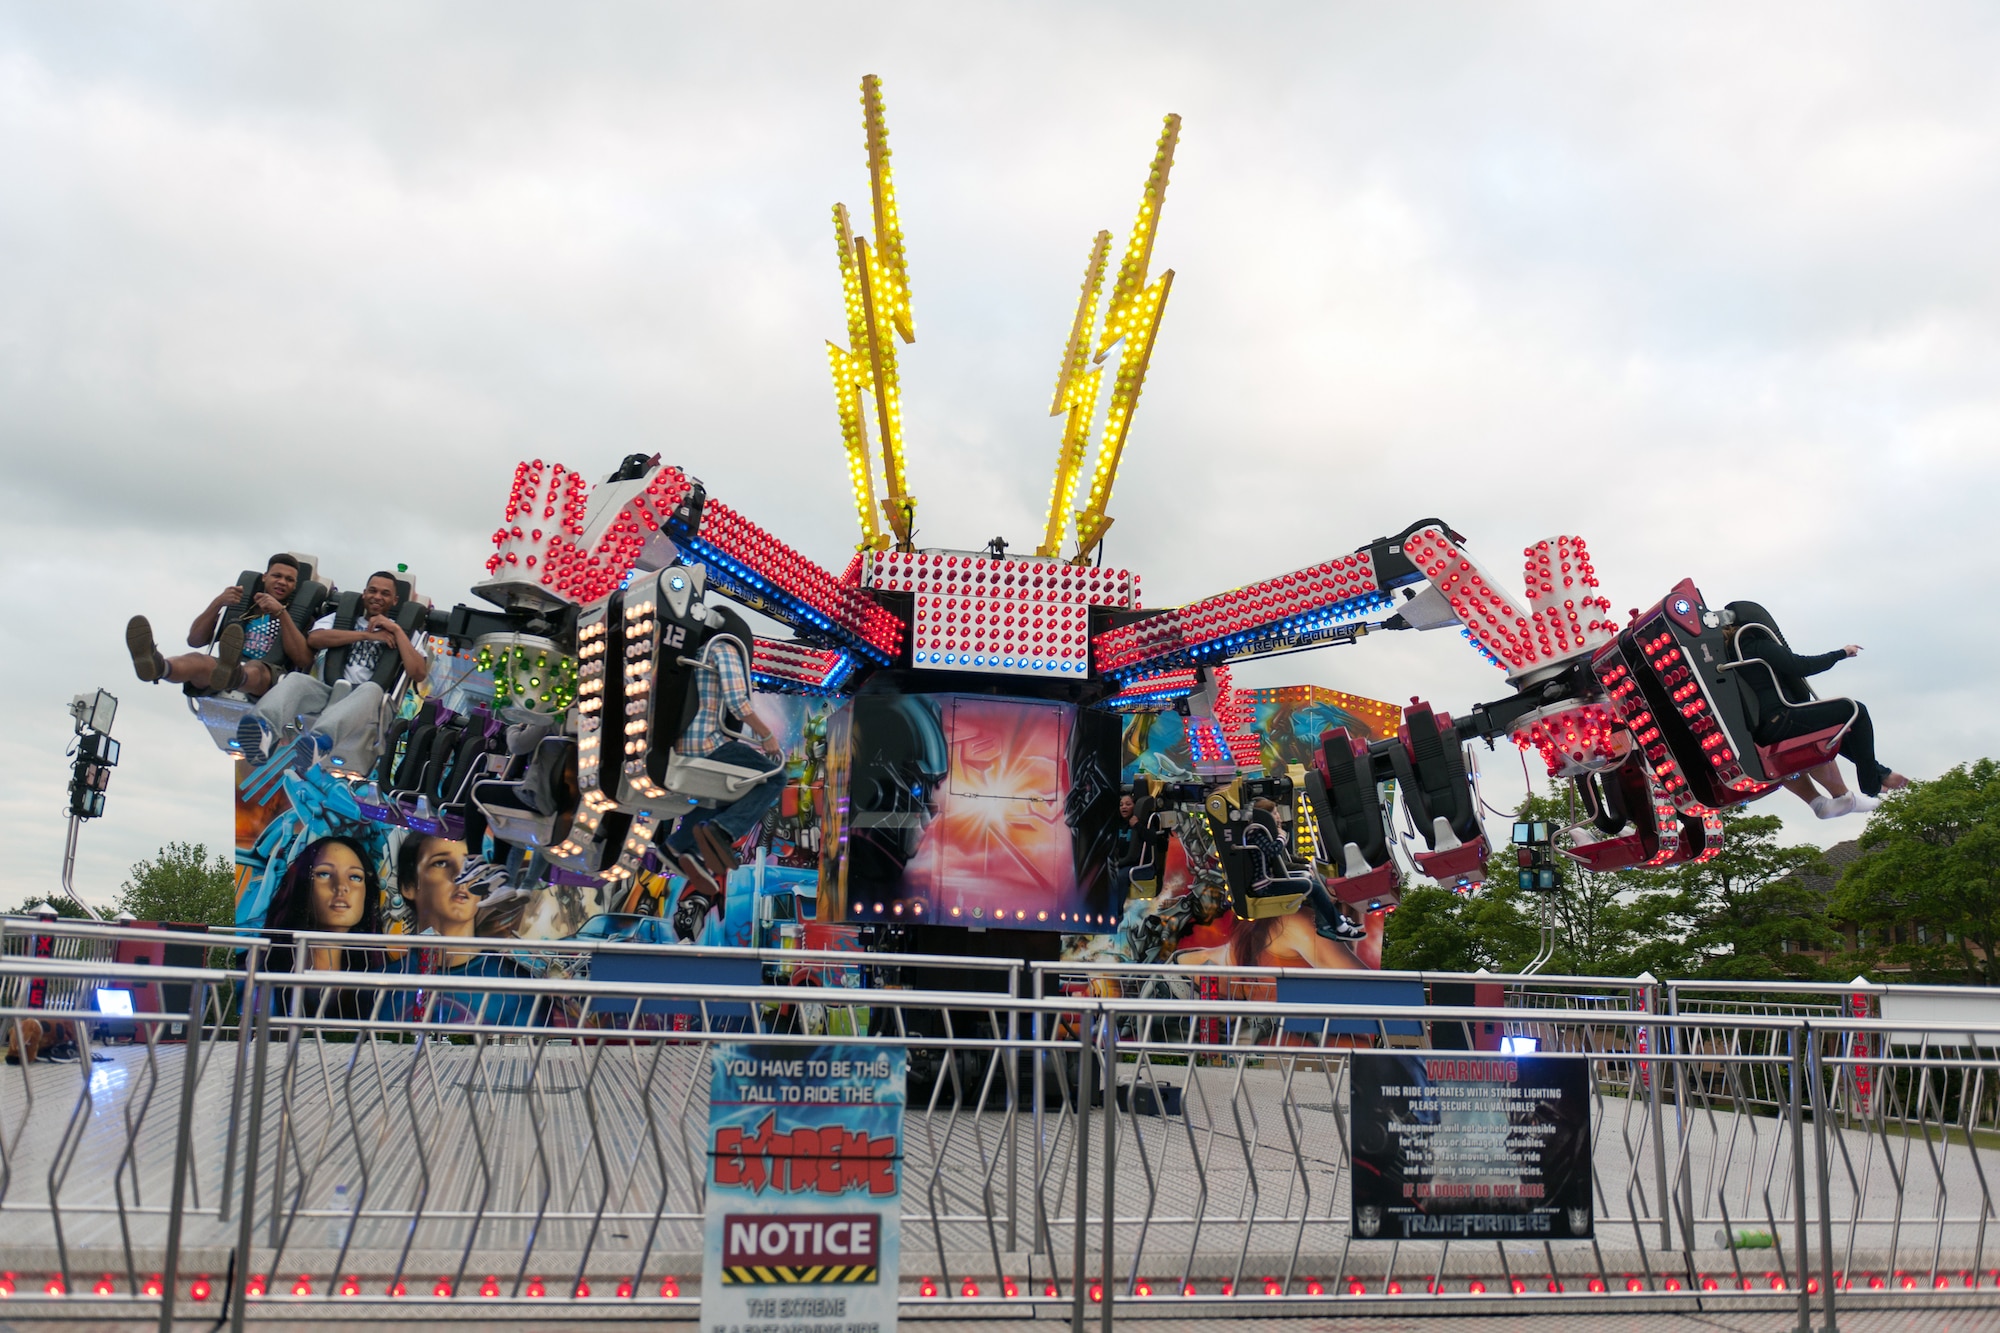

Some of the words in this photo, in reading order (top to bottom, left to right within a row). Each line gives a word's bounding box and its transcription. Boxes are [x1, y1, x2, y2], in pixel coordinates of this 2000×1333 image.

[663, 623, 687, 649] 12
[1226, 636, 1296, 657] EXTREME
[1301, 625, 1357, 644] POWER
[1701, 643, 1713, 663] 1
[1224, 829, 1232, 842] 5
[725, 1060, 757, 1077] YOU
[761, 1060, 804, 1077] HAVE
[807, 1060, 827, 1077] TO
[831, 1061, 850, 1078] BE
[855, 1061, 890, 1078] THIS
[1426, 1060, 1519, 1083] WARNING
[739, 1085, 776, 1102] TALL
[780, 1086, 800, 1102] TO
[804, 1086, 840, 1102] RIDE
[844, 1086, 874, 1103] THE
[1381, 1085, 1401, 1097] THIS
[1402, 1086, 1422, 1097] RIDE
[1424, 1086, 1465, 1098] OPERATES
[1467, 1087, 1489, 1098] WITH
[1491, 1087, 1522, 1098] STROBE
[1524, 1088, 1562, 1099] LIGHTING
[1408, 1100, 1439, 1111] PLEASE
[1441, 1101, 1472, 1112] SECURE
[1474, 1101, 1489, 1112] ALL
[1491, 1101, 1536, 1112] VALUABLES
[1388, 1121, 1442, 1134] Management
[1444, 1123, 1460, 1133] will
[1461, 1124, 1475, 1133] not
[1477, 1124, 1487, 1133] be
[1489, 1124, 1507, 1134] held
[1509, 1124, 1557, 1136] responsible
[1399, 1137, 1411, 1147] for
[1413, 1139, 1428, 1149] any
[1430, 1137, 1448, 1147] loss
[1450, 1140, 1459, 1148] or
[1461, 1138, 1492, 1149] damage
[1495, 1139, 1504, 1148] to
[1506, 1138, 1546, 1149] valuables.
[714, 1109, 896, 1196] EXTREME
[1406, 1151, 1423, 1161] This
[1425, 1151, 1433, 1161] is
[1442, 1152, 1458, 1162] fast
[1460, 1152, 1492, 1163] moving,
[1493, 1152, 1522, 1162] motion
[1524, 1152, 1541, 1162] ride
[1403, 1165, 1419, 1175] and
[1421, 1166, 1437, 1175] will
[1439, 1166, 1456, 1177] only
[1458, 1166, 1476, 1177] stop
[1478, 1166, 1486, 1175] in
[1488, 1166, 1543, 1178] emergencies.
[1403, 1183, 1415, 1198] IF
[1417, 1183, 1431, 1198] IN
[1435, 1184, 1471, 1198] DOUBT
[1474, 1184, 1489, 1198] DO
[1493, 1184, 1517, 1198] NOT
[1519, 1184, 1545, 1198] RIDE
[1400, 1213, 1551, 1237] TRANSFORMERS
[730, 1222, 871, 1255] NOTICE
[747, 1299, 777, 1318] THE
[779, 1298, 846, 1317] EXTREME
